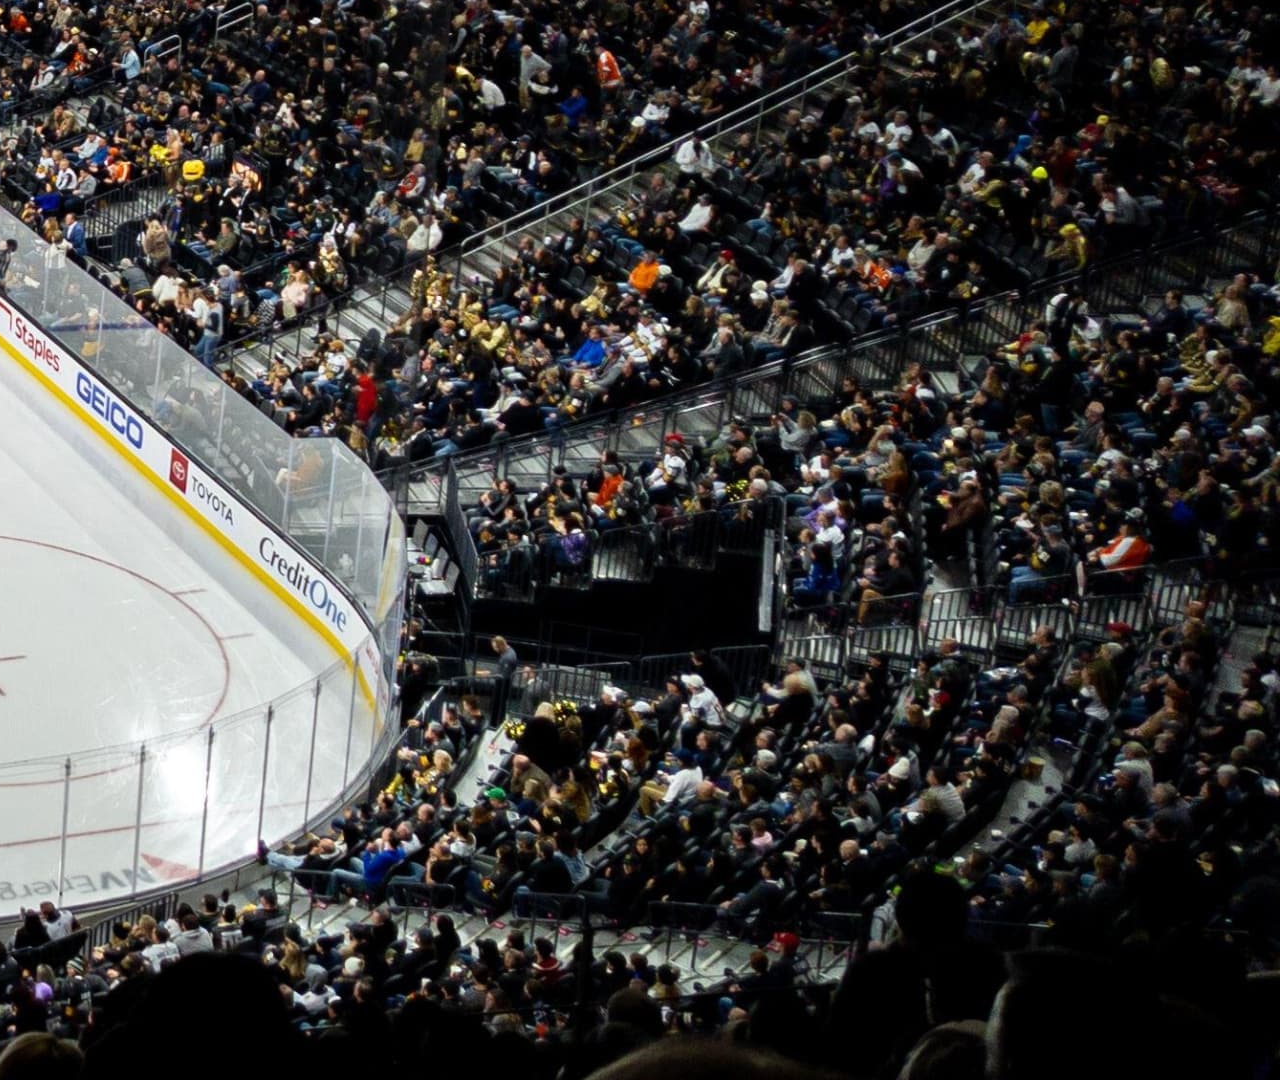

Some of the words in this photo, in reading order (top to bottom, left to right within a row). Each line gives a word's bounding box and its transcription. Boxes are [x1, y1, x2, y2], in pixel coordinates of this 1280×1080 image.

[15, 317, 60, 372] Staples
[76, 372, 143, 449] GEICO
[192, 477, 234, 525] TOYOTA
[259, 537, 347, 632] CreditOne
